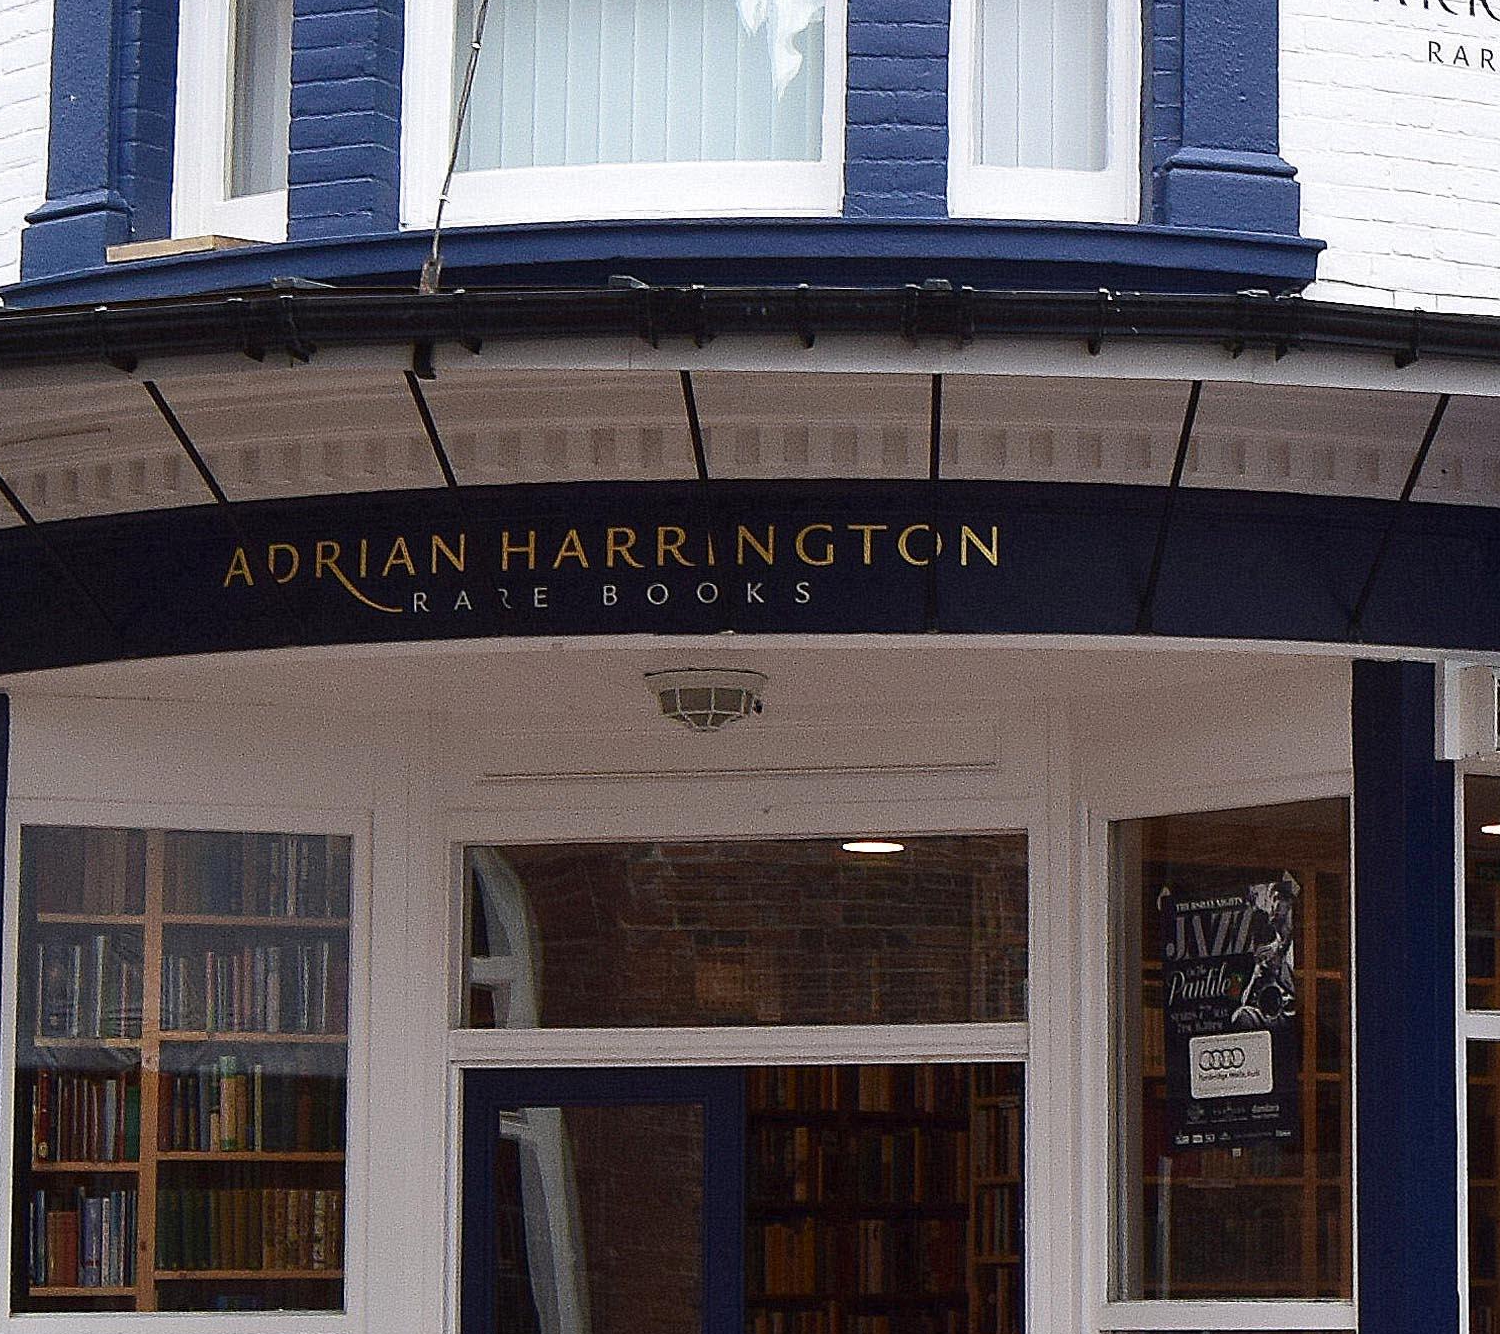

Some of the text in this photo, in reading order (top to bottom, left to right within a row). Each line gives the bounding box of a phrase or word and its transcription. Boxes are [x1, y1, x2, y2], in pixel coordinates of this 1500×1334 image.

[224, 523, 1000, 613] ADRIAN HARRINGTON
[602, 579, 814, 606] BOOKS
[1166, 906, 1254, 961] JAZZ
